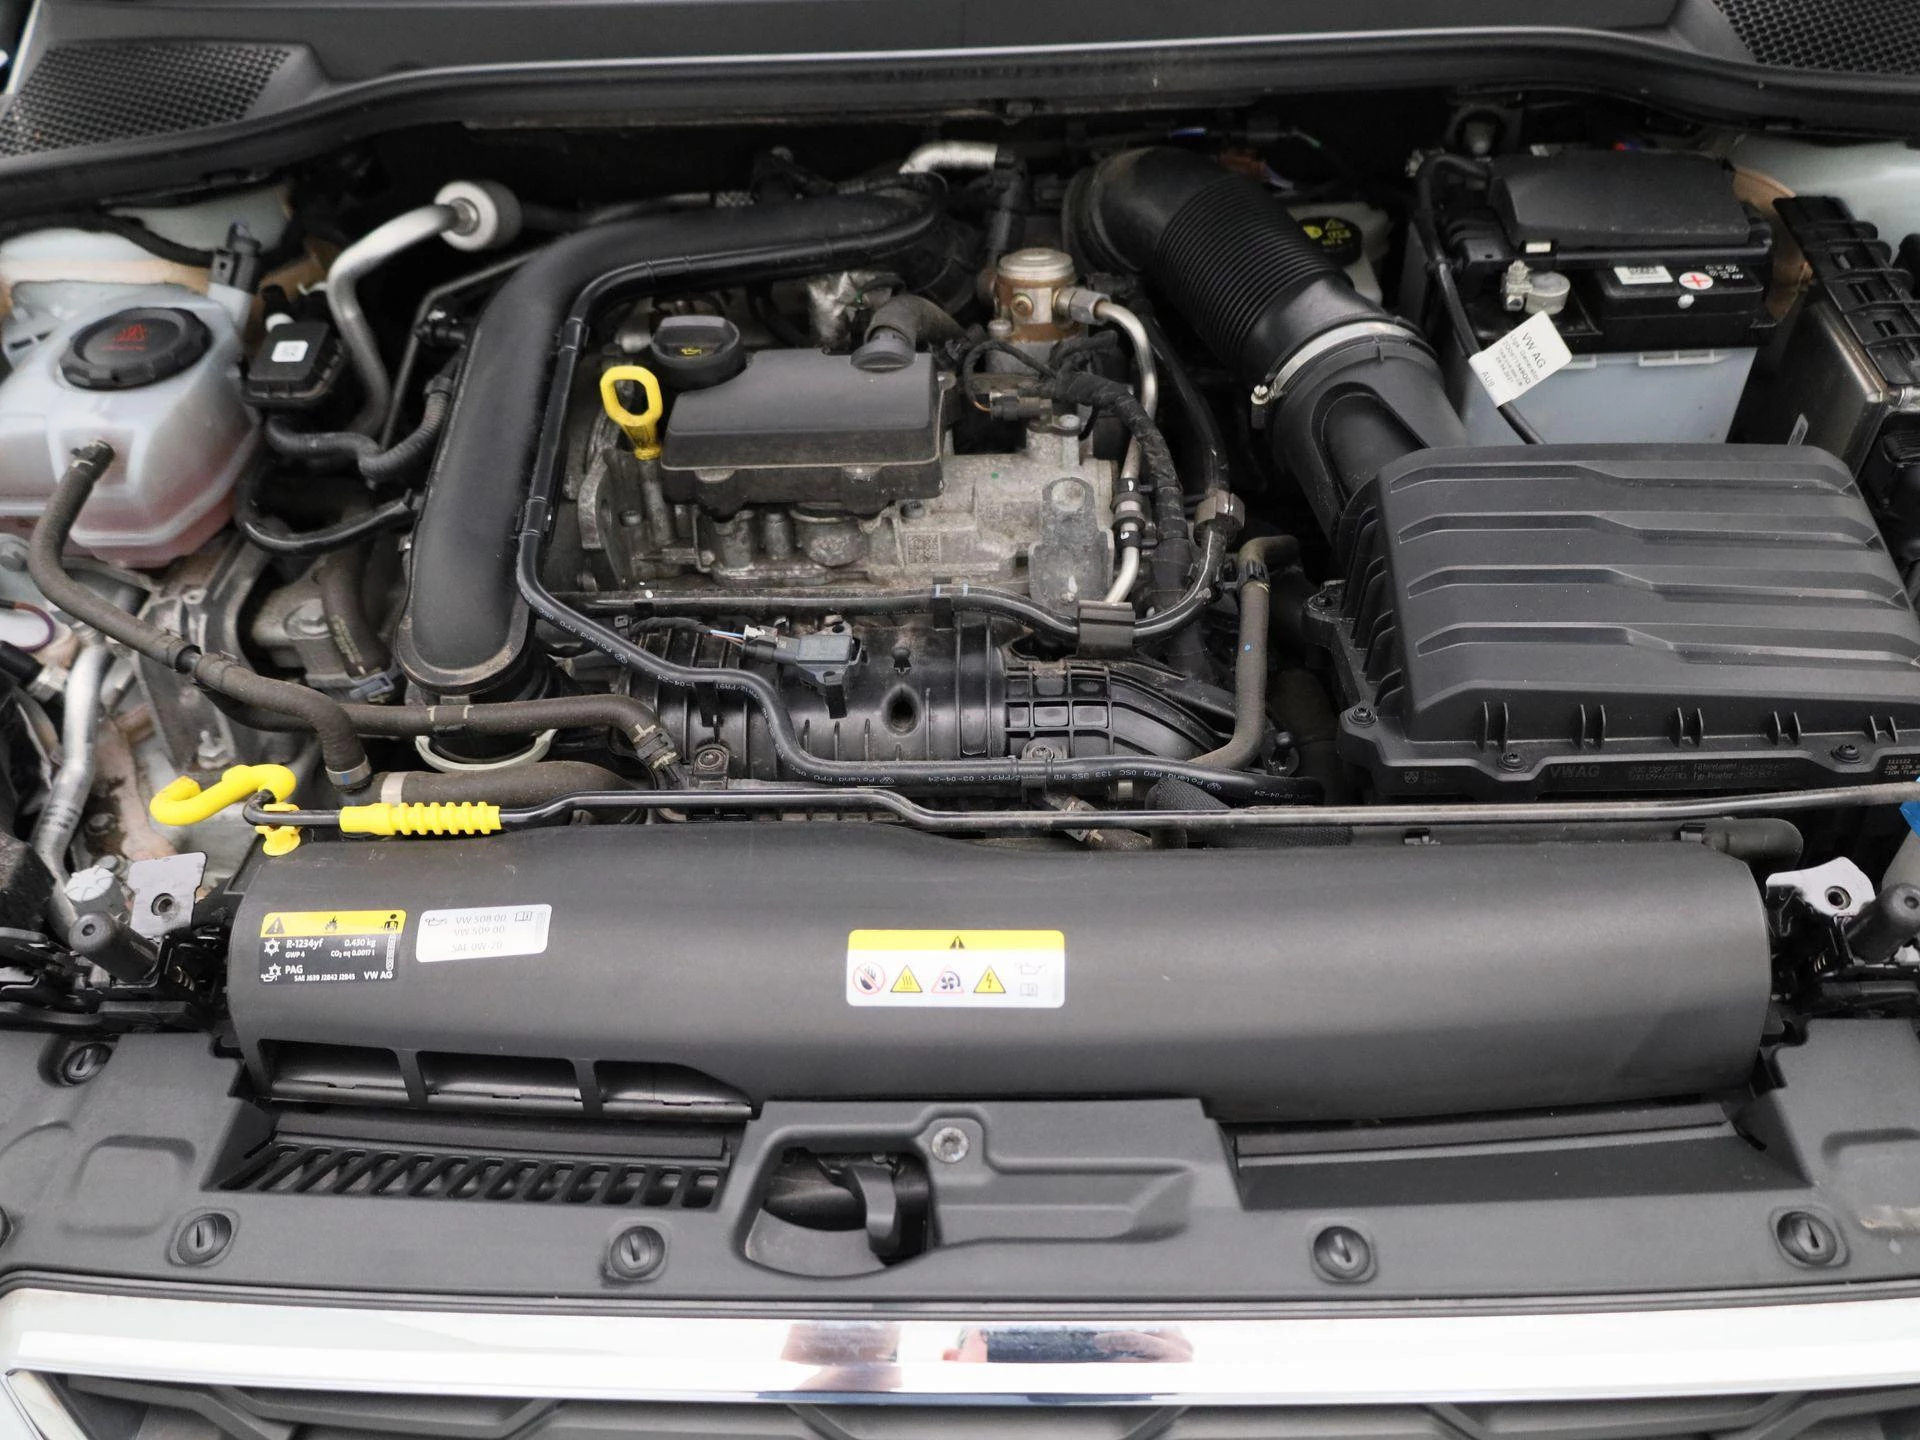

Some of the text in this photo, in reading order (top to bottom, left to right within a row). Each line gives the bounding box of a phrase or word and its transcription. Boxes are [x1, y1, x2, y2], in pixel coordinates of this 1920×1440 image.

[1522, 332, 1546, 369] VW AG
[1167, 772, 1204, 787] Poland
[455, 916, 472, 925] VW
[454, 927, 470, 936] VW
[286, 938, 324, 950] R-1234yf
[366, 938, 376, 948] kg
[285, 964, 304, 975] PAG
[363, 970, 394, 980] VW AG
